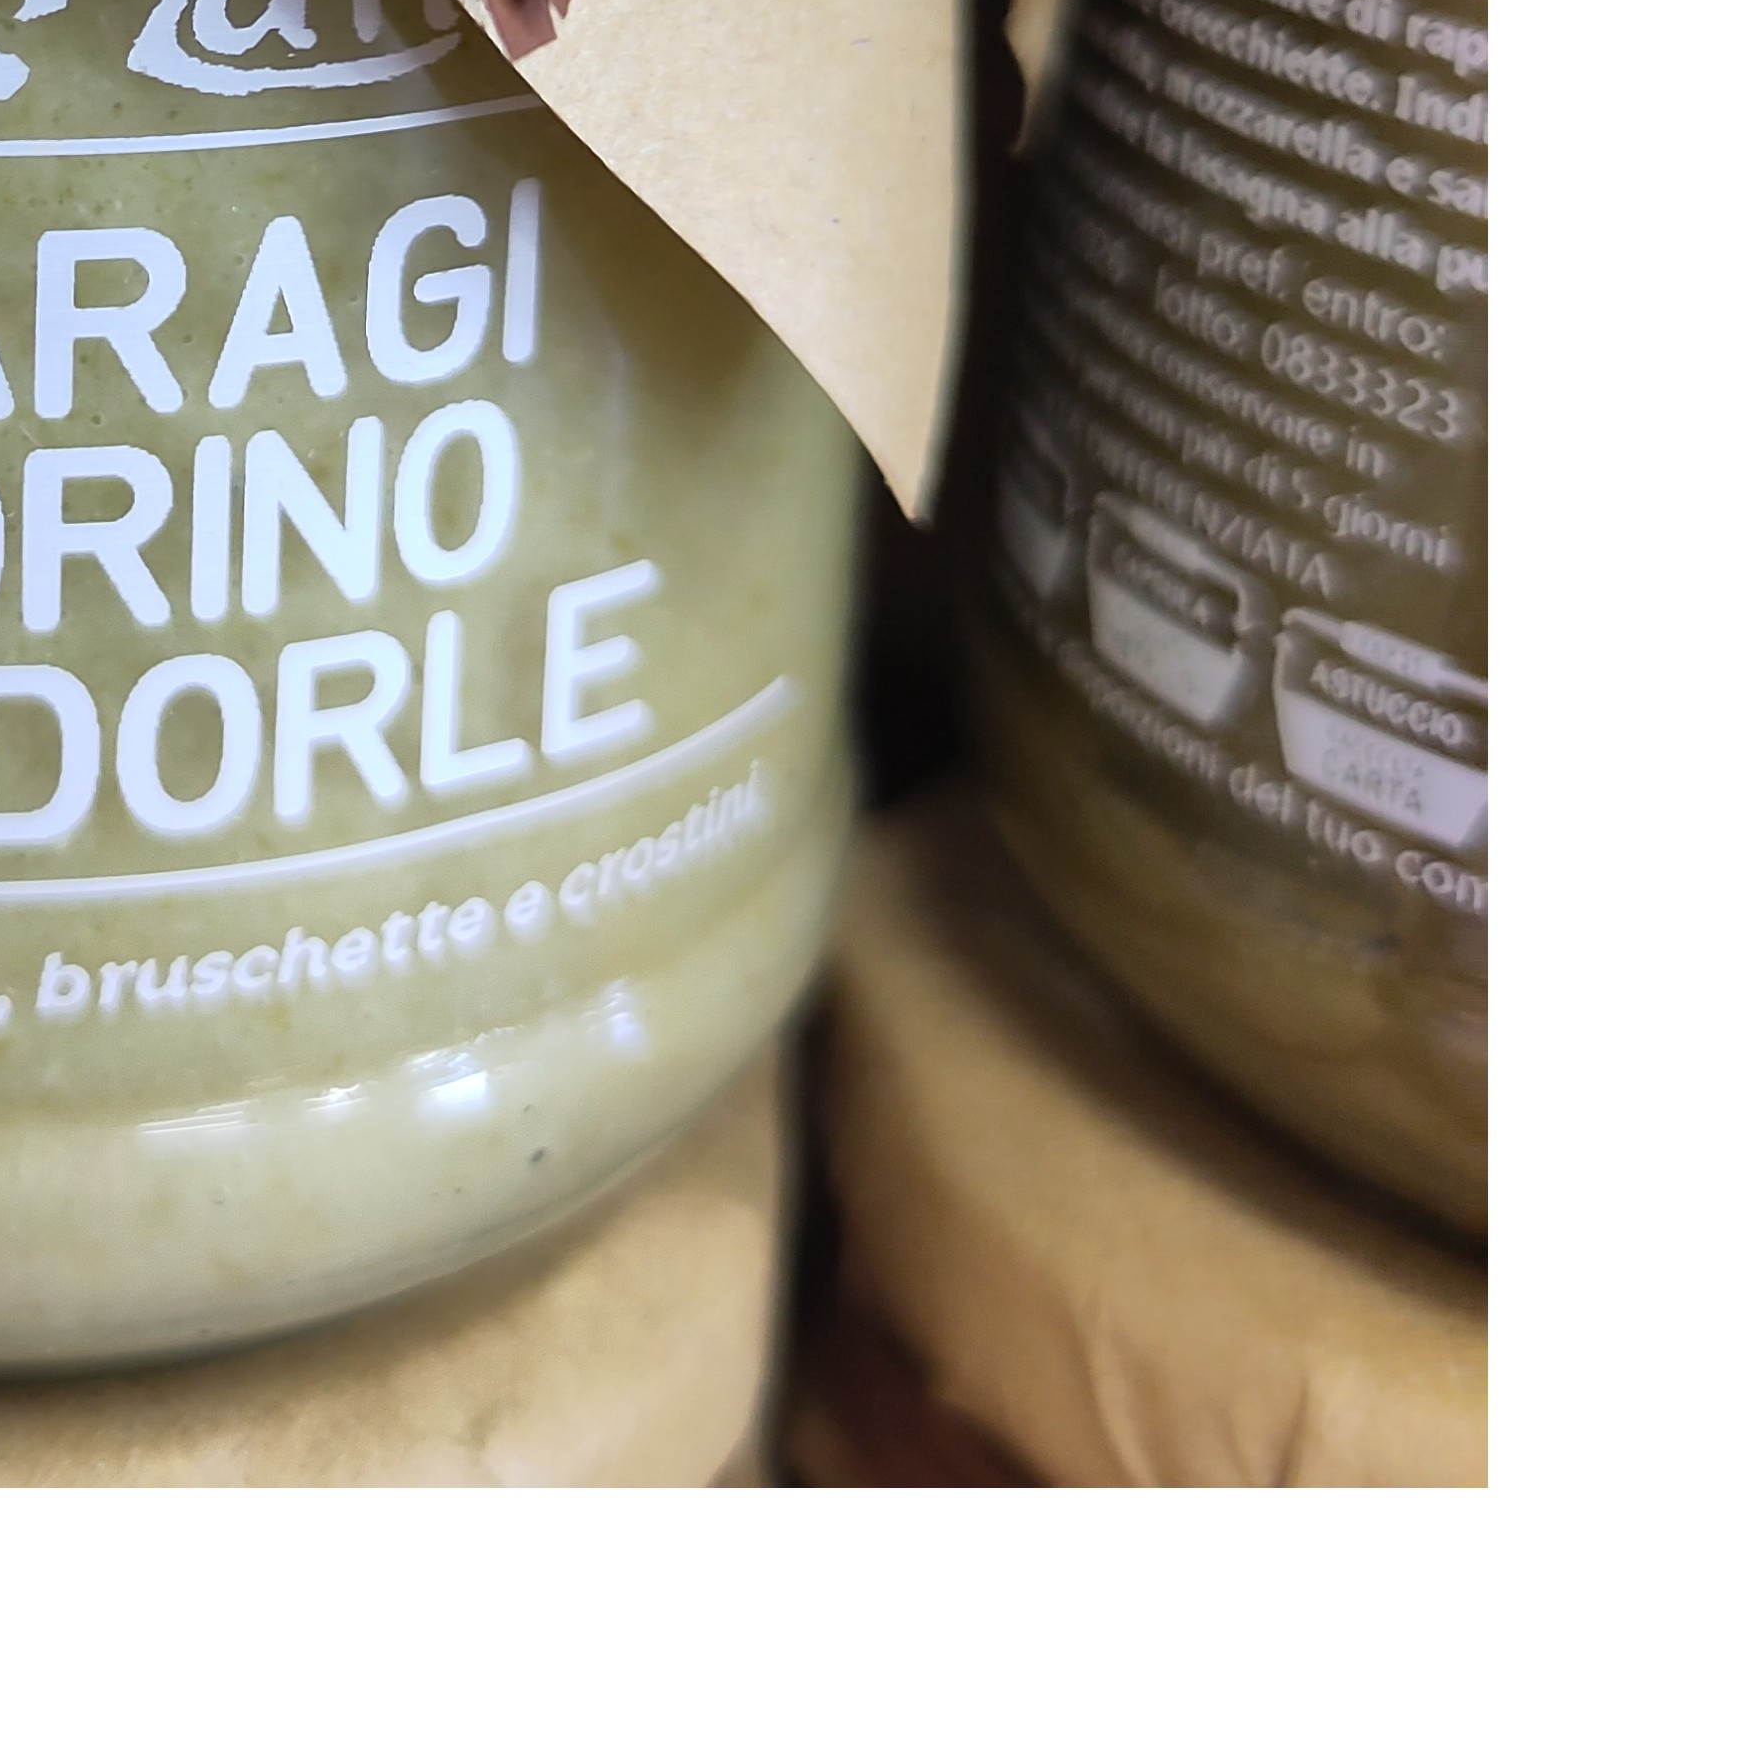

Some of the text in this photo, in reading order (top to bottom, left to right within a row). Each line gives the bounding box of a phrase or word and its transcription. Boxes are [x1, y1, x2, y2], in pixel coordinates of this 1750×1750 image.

[1163, 61, 1378, 184] mozzarella
[1385, 155, 1422, 196] e
[1427, 168, 1488, 220] sa
[1394, 73, 1488, 144] Ind
[1336, 206, 1428, 272] alla
[1154, 261, 1250, 356] lotto:
[1260, 322, 1464, 442] 0833323
[1301, 276, 1450, 362] entro:
[1150, 342, 1336, 456] conservare
[1345, 424, 1390, 482] in
[1323, 490, 1460, 572] giorni
[1310, 658, 1466, 750] ASTUCCIO
[1228, 762, 1296, 827] del
[1306, 798, 1384, 864] tuo
[35, 896, 492, 1019] bruschette
[503, 879, 553, 931] e
[557, 758, 768, 912] crostini
